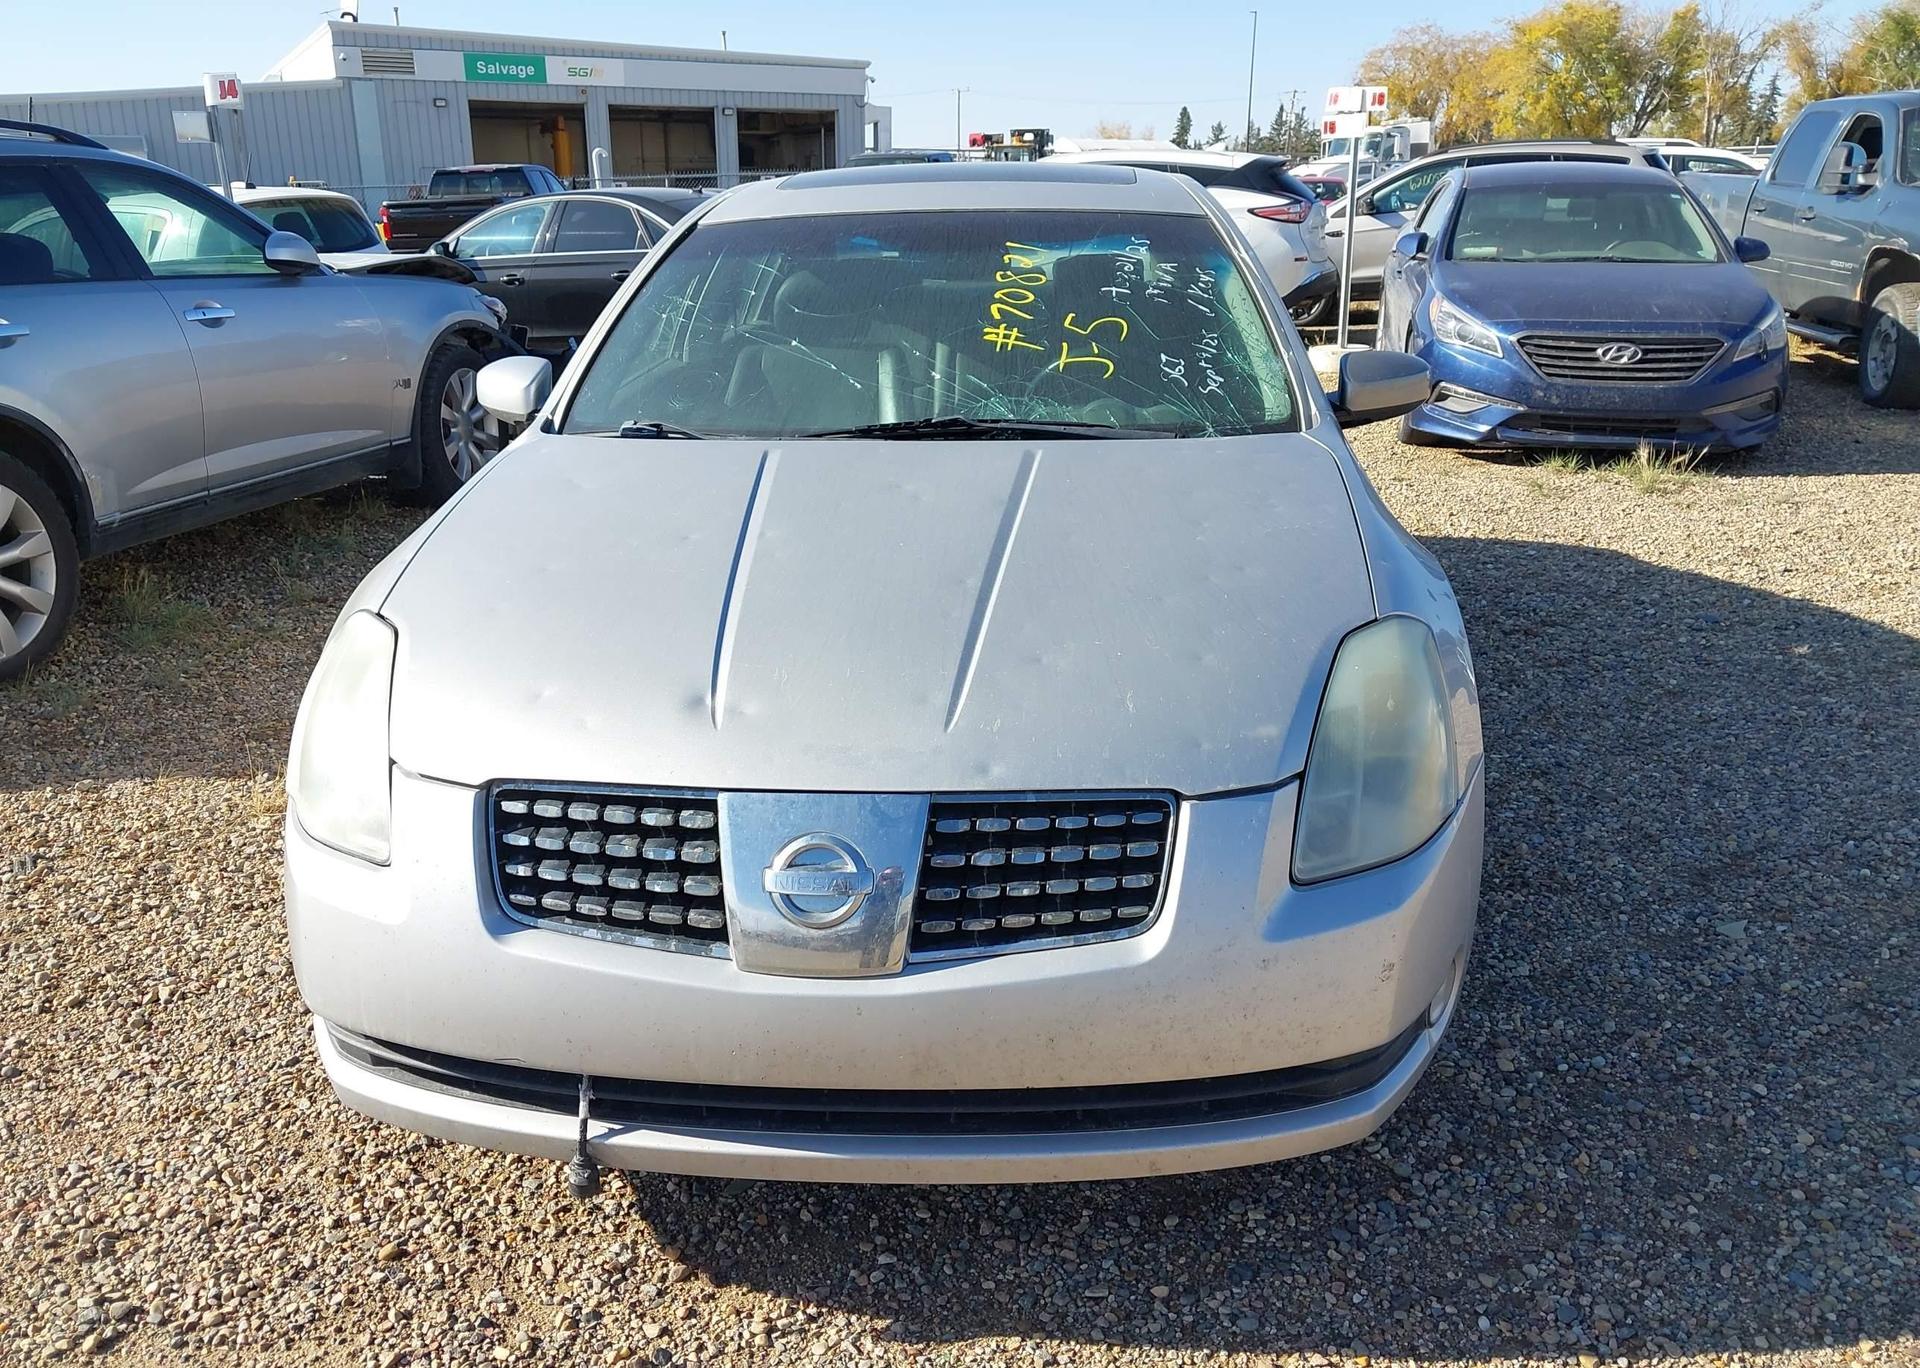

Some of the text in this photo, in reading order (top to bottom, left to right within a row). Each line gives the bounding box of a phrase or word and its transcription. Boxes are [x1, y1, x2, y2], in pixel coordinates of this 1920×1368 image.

[476, 61, 535, 78] Salvage
[567, 66, 594, 78] SGI
[218, 79, 239, 100] J4
[983, 241, 1050, 352] #70821
[1059, 312, 1128, 379] J-5
[773, 874, 864, 893] NISSAN
